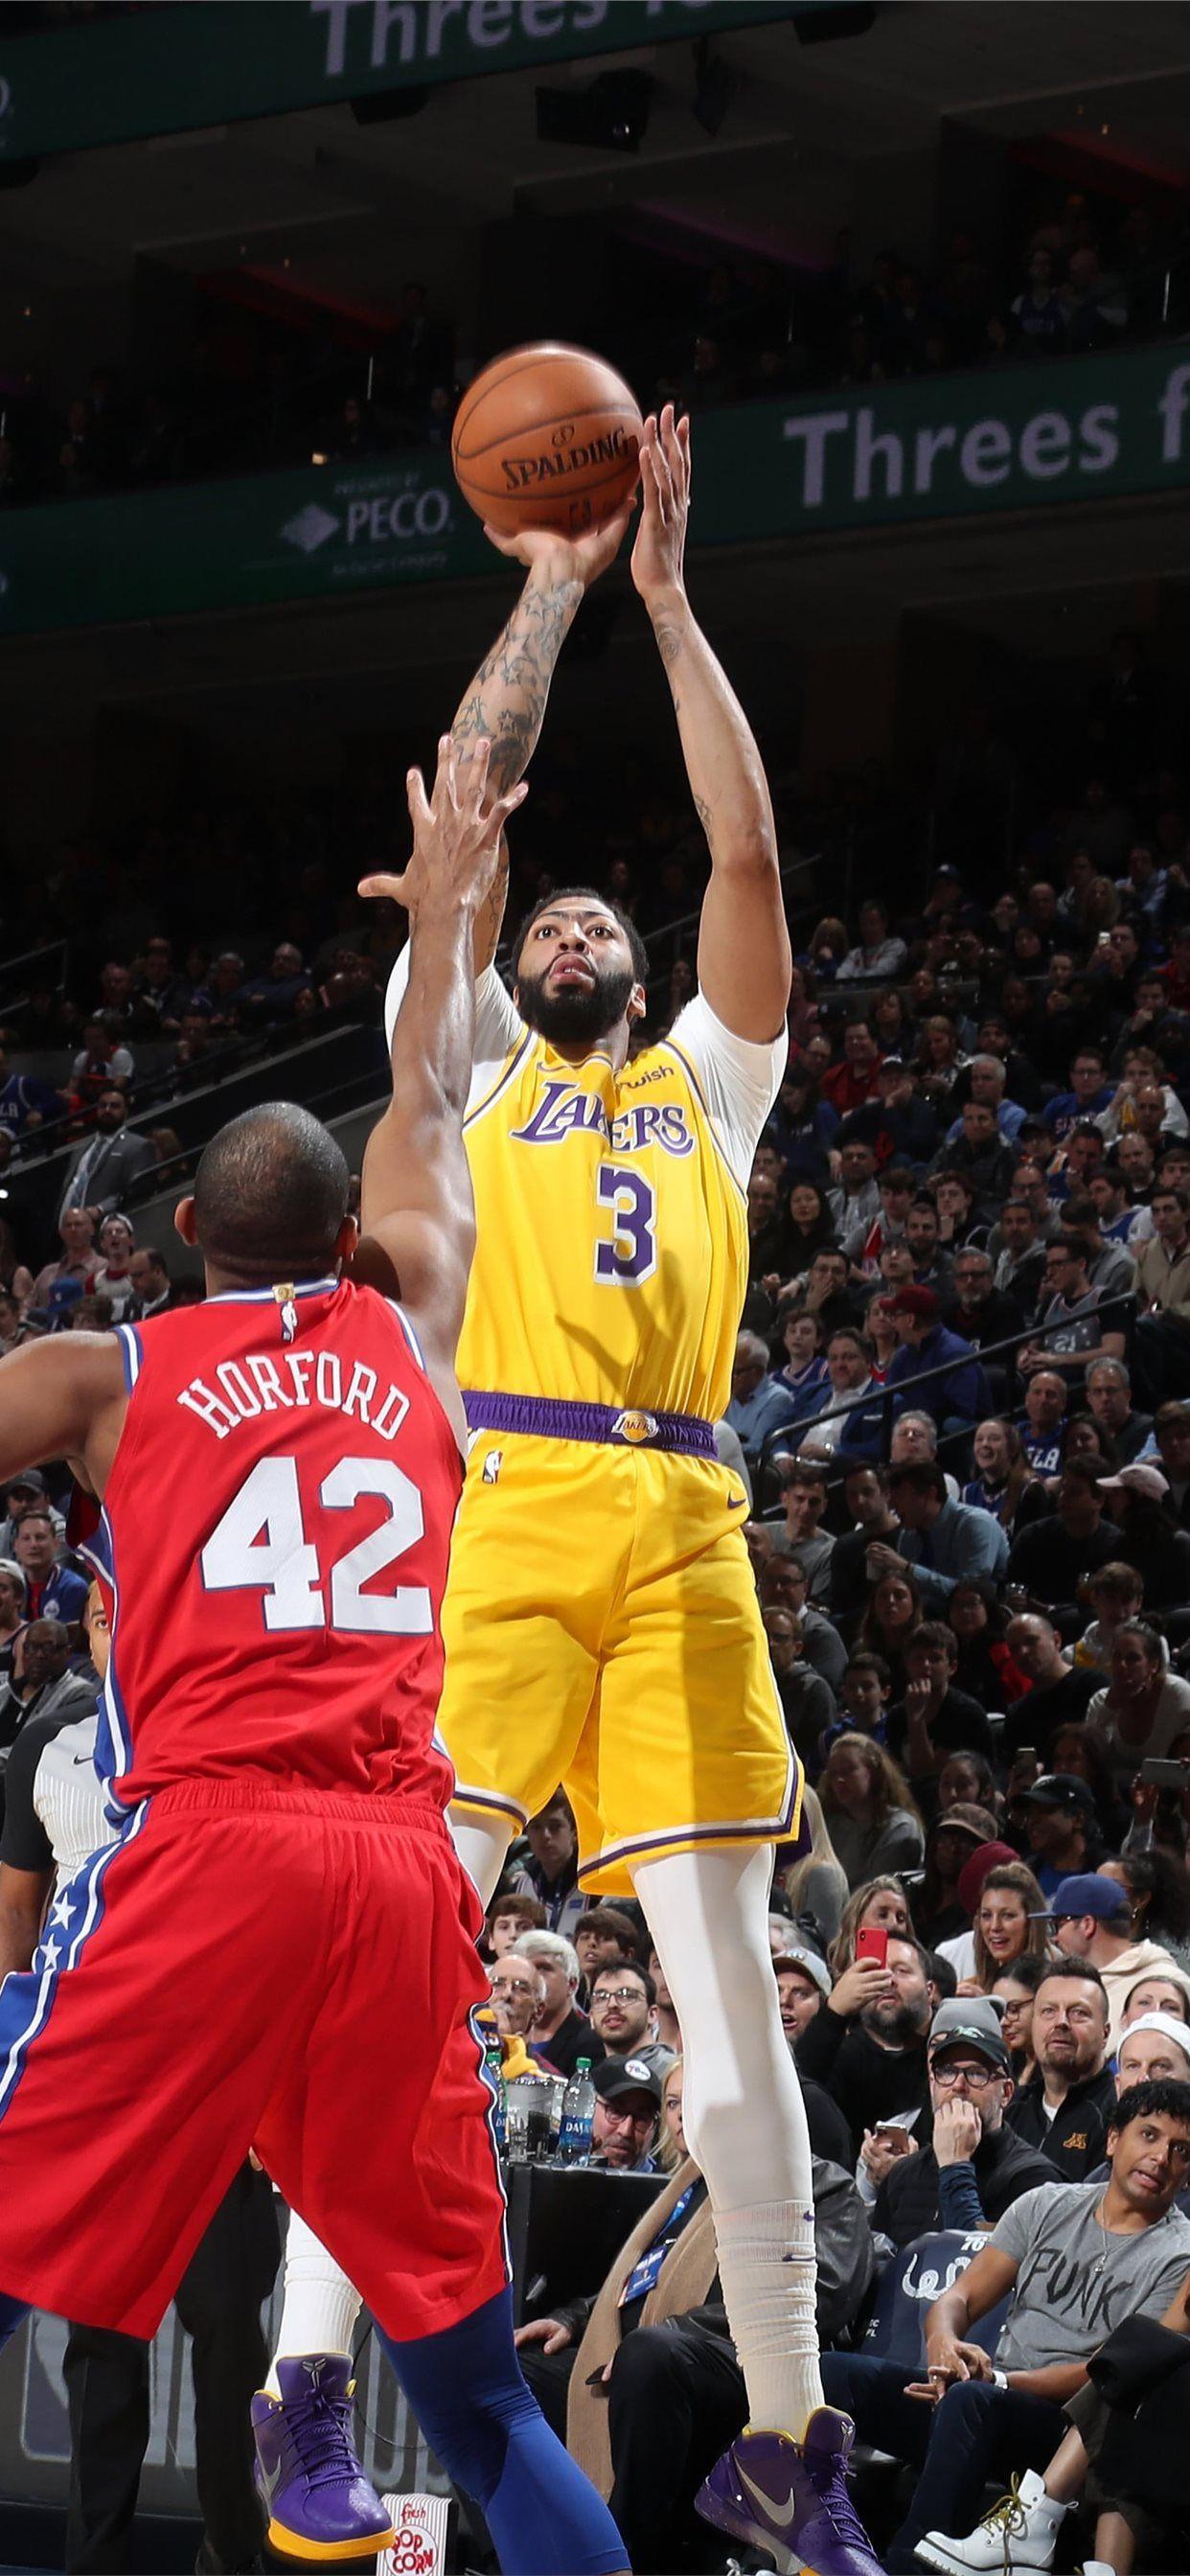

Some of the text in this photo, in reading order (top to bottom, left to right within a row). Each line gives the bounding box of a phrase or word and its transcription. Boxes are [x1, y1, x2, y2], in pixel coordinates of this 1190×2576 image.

[501, 426, 629, 491] SPALDING
[784, 402, 1119, 508] Threes
[347, 488, 450, 545] PECO
[594, 1162, 658, 1288] 3
[176, 1350, 411, 1440] HORFORD
[200, 1455, 434, 1635] 42
[961, 2236, 989, 2252] 76
[1016, 2247, 1135, 2333] PUNK
[401, 2503, 426, 2524] fresh
[393, 2548, 433, 2574] CORN
